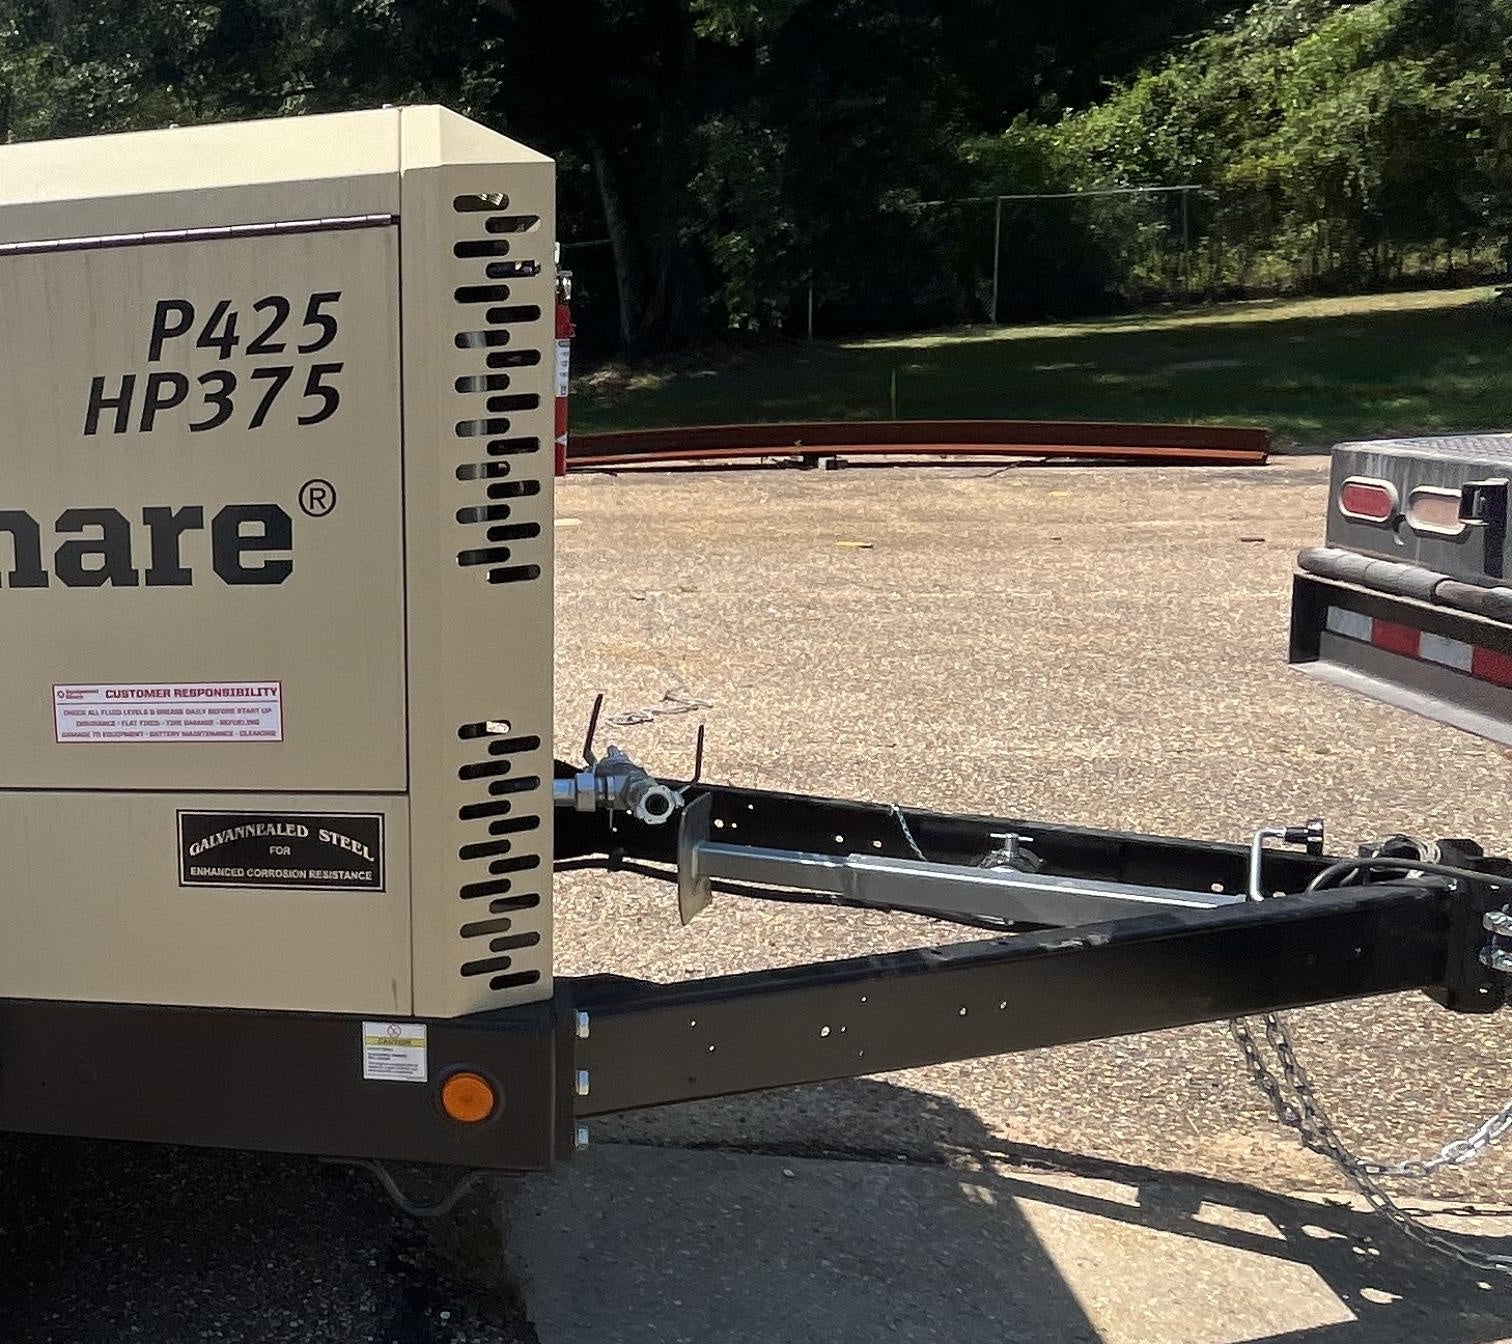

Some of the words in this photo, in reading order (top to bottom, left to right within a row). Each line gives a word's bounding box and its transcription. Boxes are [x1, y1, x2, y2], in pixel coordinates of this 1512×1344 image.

[147, 291, 342, 362] P425
[83, 362, 345, 436] HP375
[105, 688, 171, 699] CUSTOMER
[173, 687, 278, 698] RESPONSIBILITY
[189, 822, 309, 857] GALVANNEALED
[318, 828, 376, 863] STEEL
[269, 845, 292, 856] FOR
[190, 866, 245, 878] ENHANCED
[246, 867, 307, 879] CORROSION
[308, 869, 374, 881] RESISTANCE
